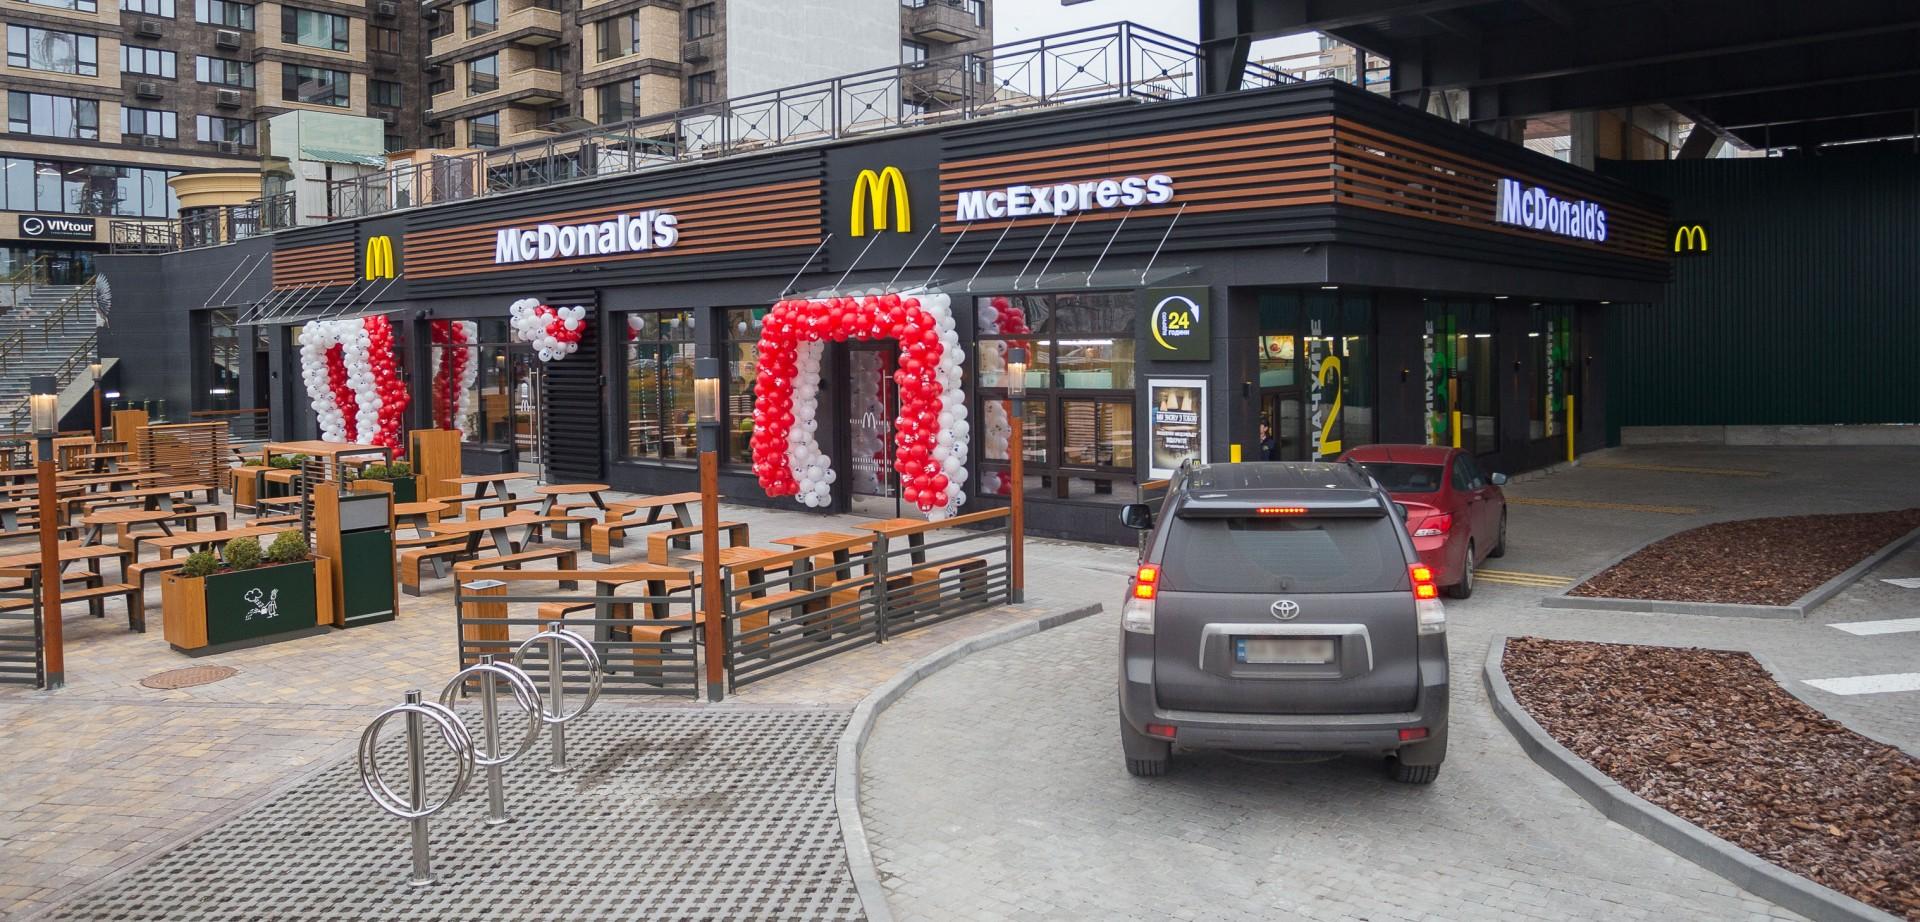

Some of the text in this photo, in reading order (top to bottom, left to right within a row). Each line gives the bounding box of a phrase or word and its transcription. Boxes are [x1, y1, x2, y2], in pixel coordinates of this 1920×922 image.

[956, 174, 1174, 221] McExpress
[1496, 178, 1606, 242] McDonald's
[47, 220, 93, 232] VIVtour
[495, 208, 679, 263] McDonald's
[1168, 311, 1190, 329] 24
[1318, 355, 1341, 455] 2
